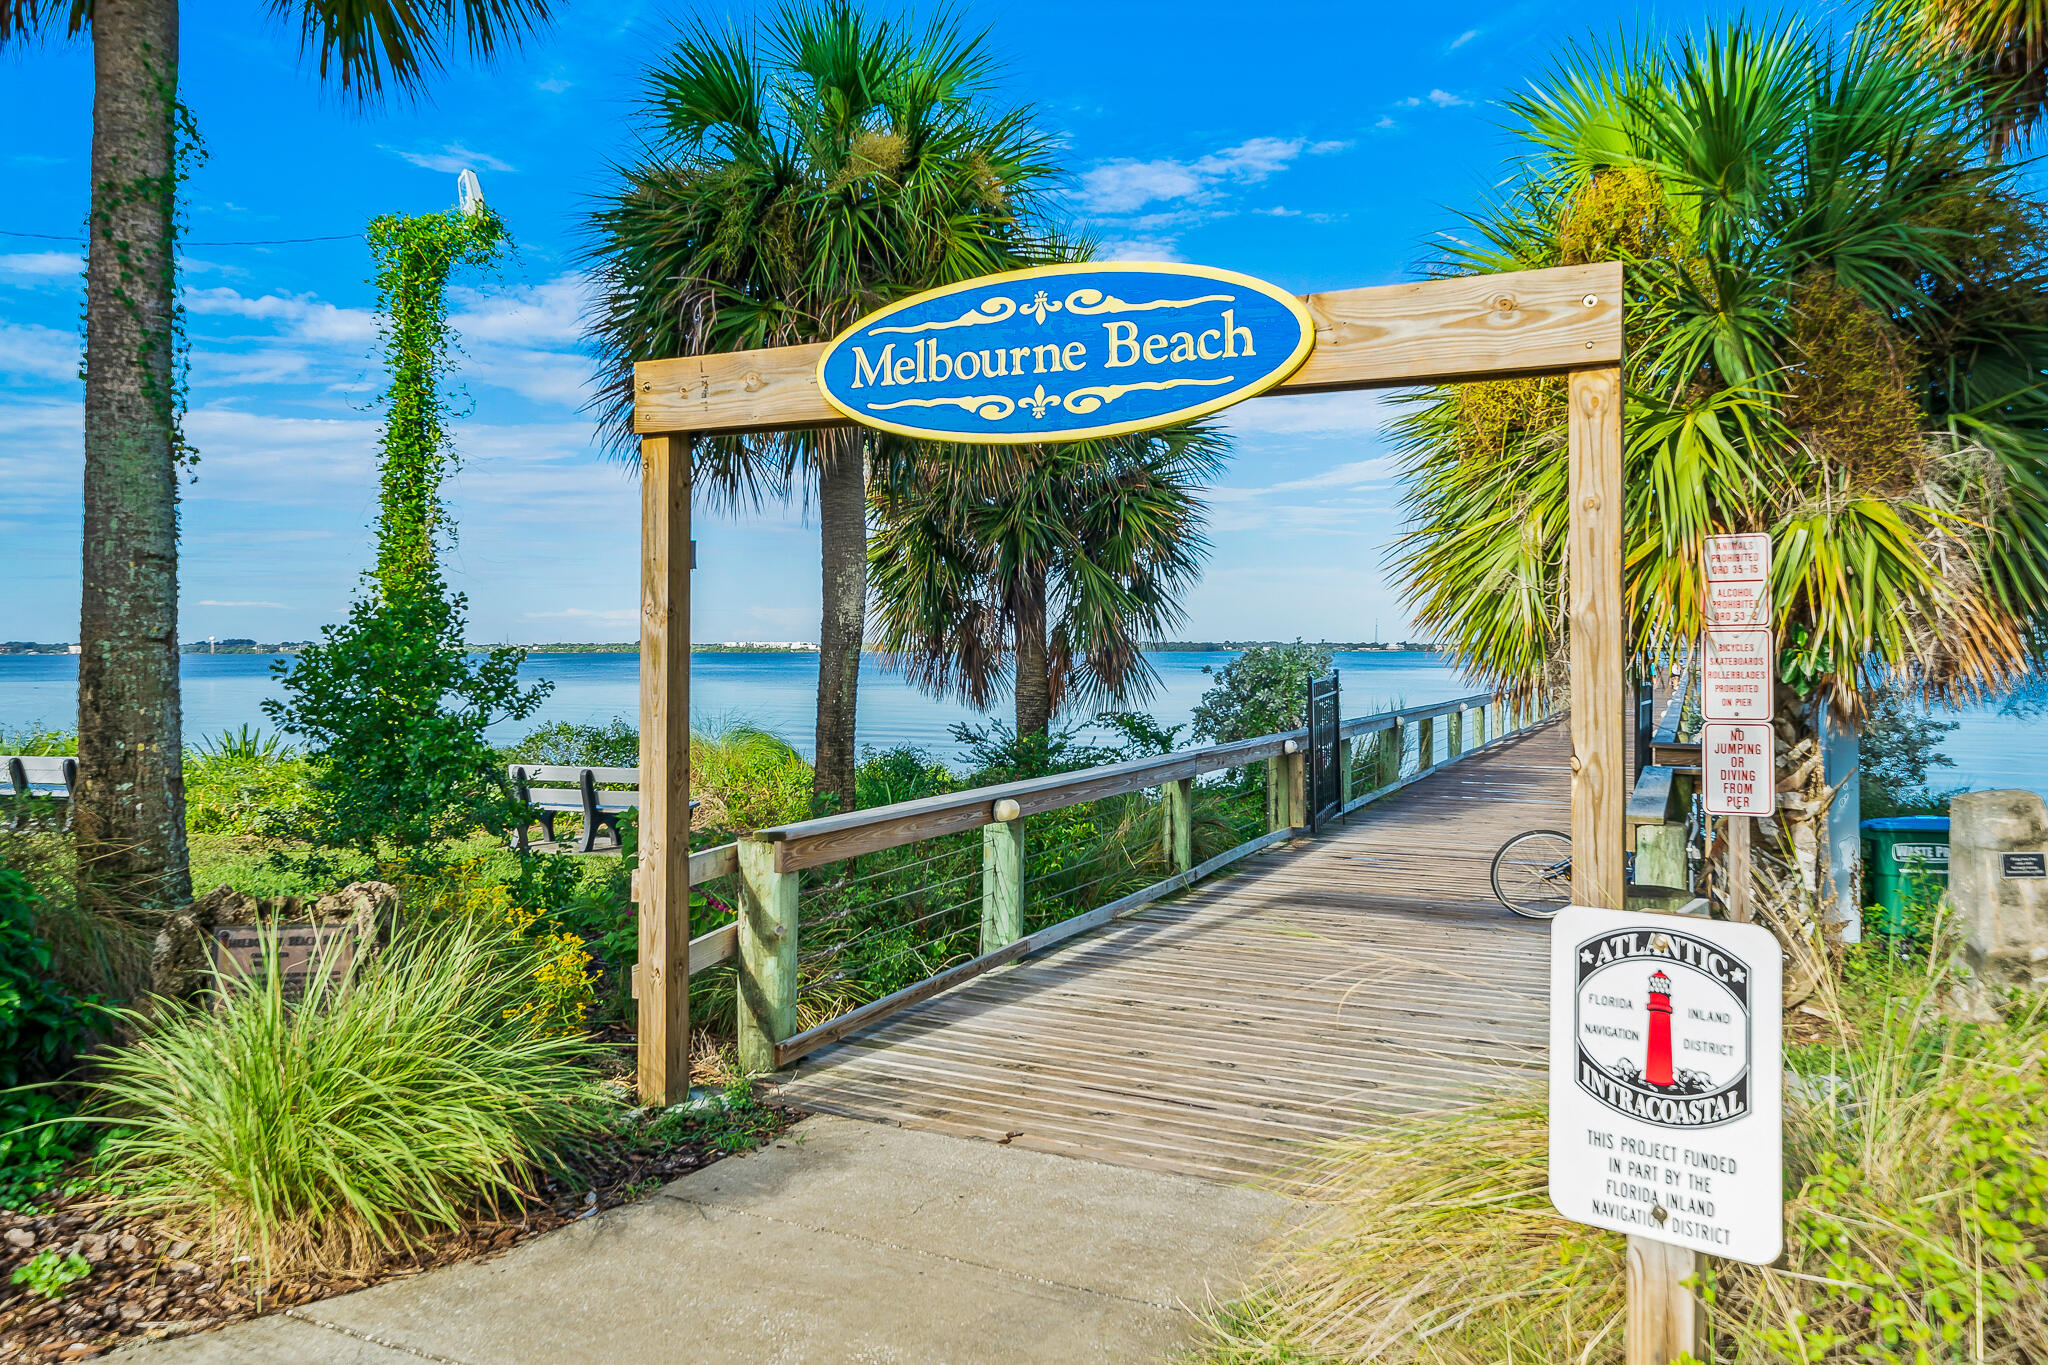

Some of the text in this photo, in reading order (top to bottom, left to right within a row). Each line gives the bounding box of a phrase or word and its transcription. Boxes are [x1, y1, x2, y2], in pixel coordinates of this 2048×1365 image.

[850, 309, 1257, 389] Melbourne Beach
[1716, 541, 1753, 551] ANIMALS
[1711, 553, 1759, 563] PROHIBITED
[1712, 565, 1728, 575] ORD
[1718, 588, 1754, 597] ALCOHOL
[1714, 612, 1731, 621] ORD
[1718, 643, 1754, 653] BICYCLES
[1710, 657, 1764, 666] SKATEBOARDS
[1708, 671, 1765, 680] ROLLERBLADES
[1715, 684, 1759, 693] PROHIBITED
[1722, 698, 1752, 707] ON PIER
[1730, 730, 1744, 742] NO
[1714, 743, 1761, 755] JUMPING
[1731, 756, 1744, 768] OR
[1720, 770, 1756, 781] DIVING
[1723, 783, 1753, 794] FROM
[1727, 796, 1750, 808] PIER
[1895, 845, 1950, 858] WASTE PR
[1594, 932, 1729, 983] ATLANTIC
[1588, 993, 1633, 1010] FLORIDA
[1688, 1008, 1731, 1025] INLAND
[1584, 1023, 1640, 1041] NAVIGATION
[1683, 1038, 1735, 1057] DISTRICT
[1581, 1061, 1745, 1125] INTRACOASTAL
[1587, 1129, 1737, 1174] THIS PROJECT FUNDED
[1609, 1157, 1713, 1194] IN PART BY THE
[1607, 1179, 1715, 1218] FLORIDA INLAND
[1672, 1217, 1731, 1245] DISTRICT
